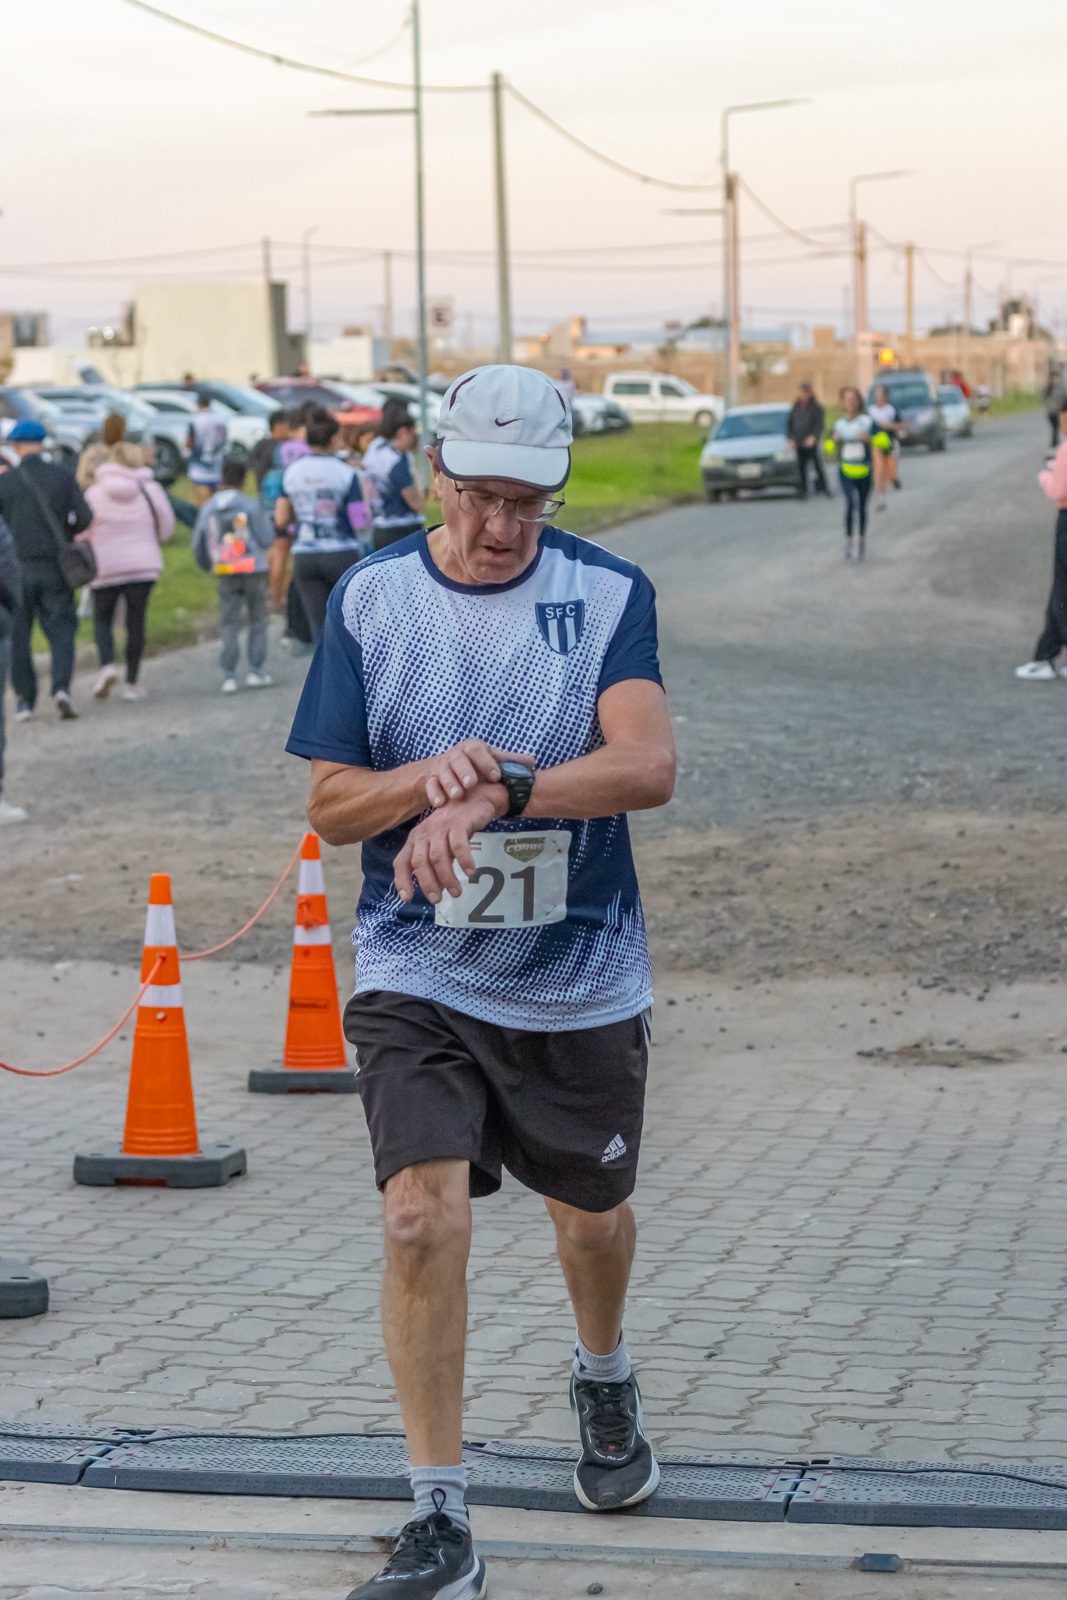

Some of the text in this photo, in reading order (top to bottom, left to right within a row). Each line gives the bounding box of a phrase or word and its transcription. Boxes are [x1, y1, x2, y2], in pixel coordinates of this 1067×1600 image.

[545, 604, 576, 619] SFC
[468, 866, 535, 923] 21
[601, 1145, 627, 1163] adidas
